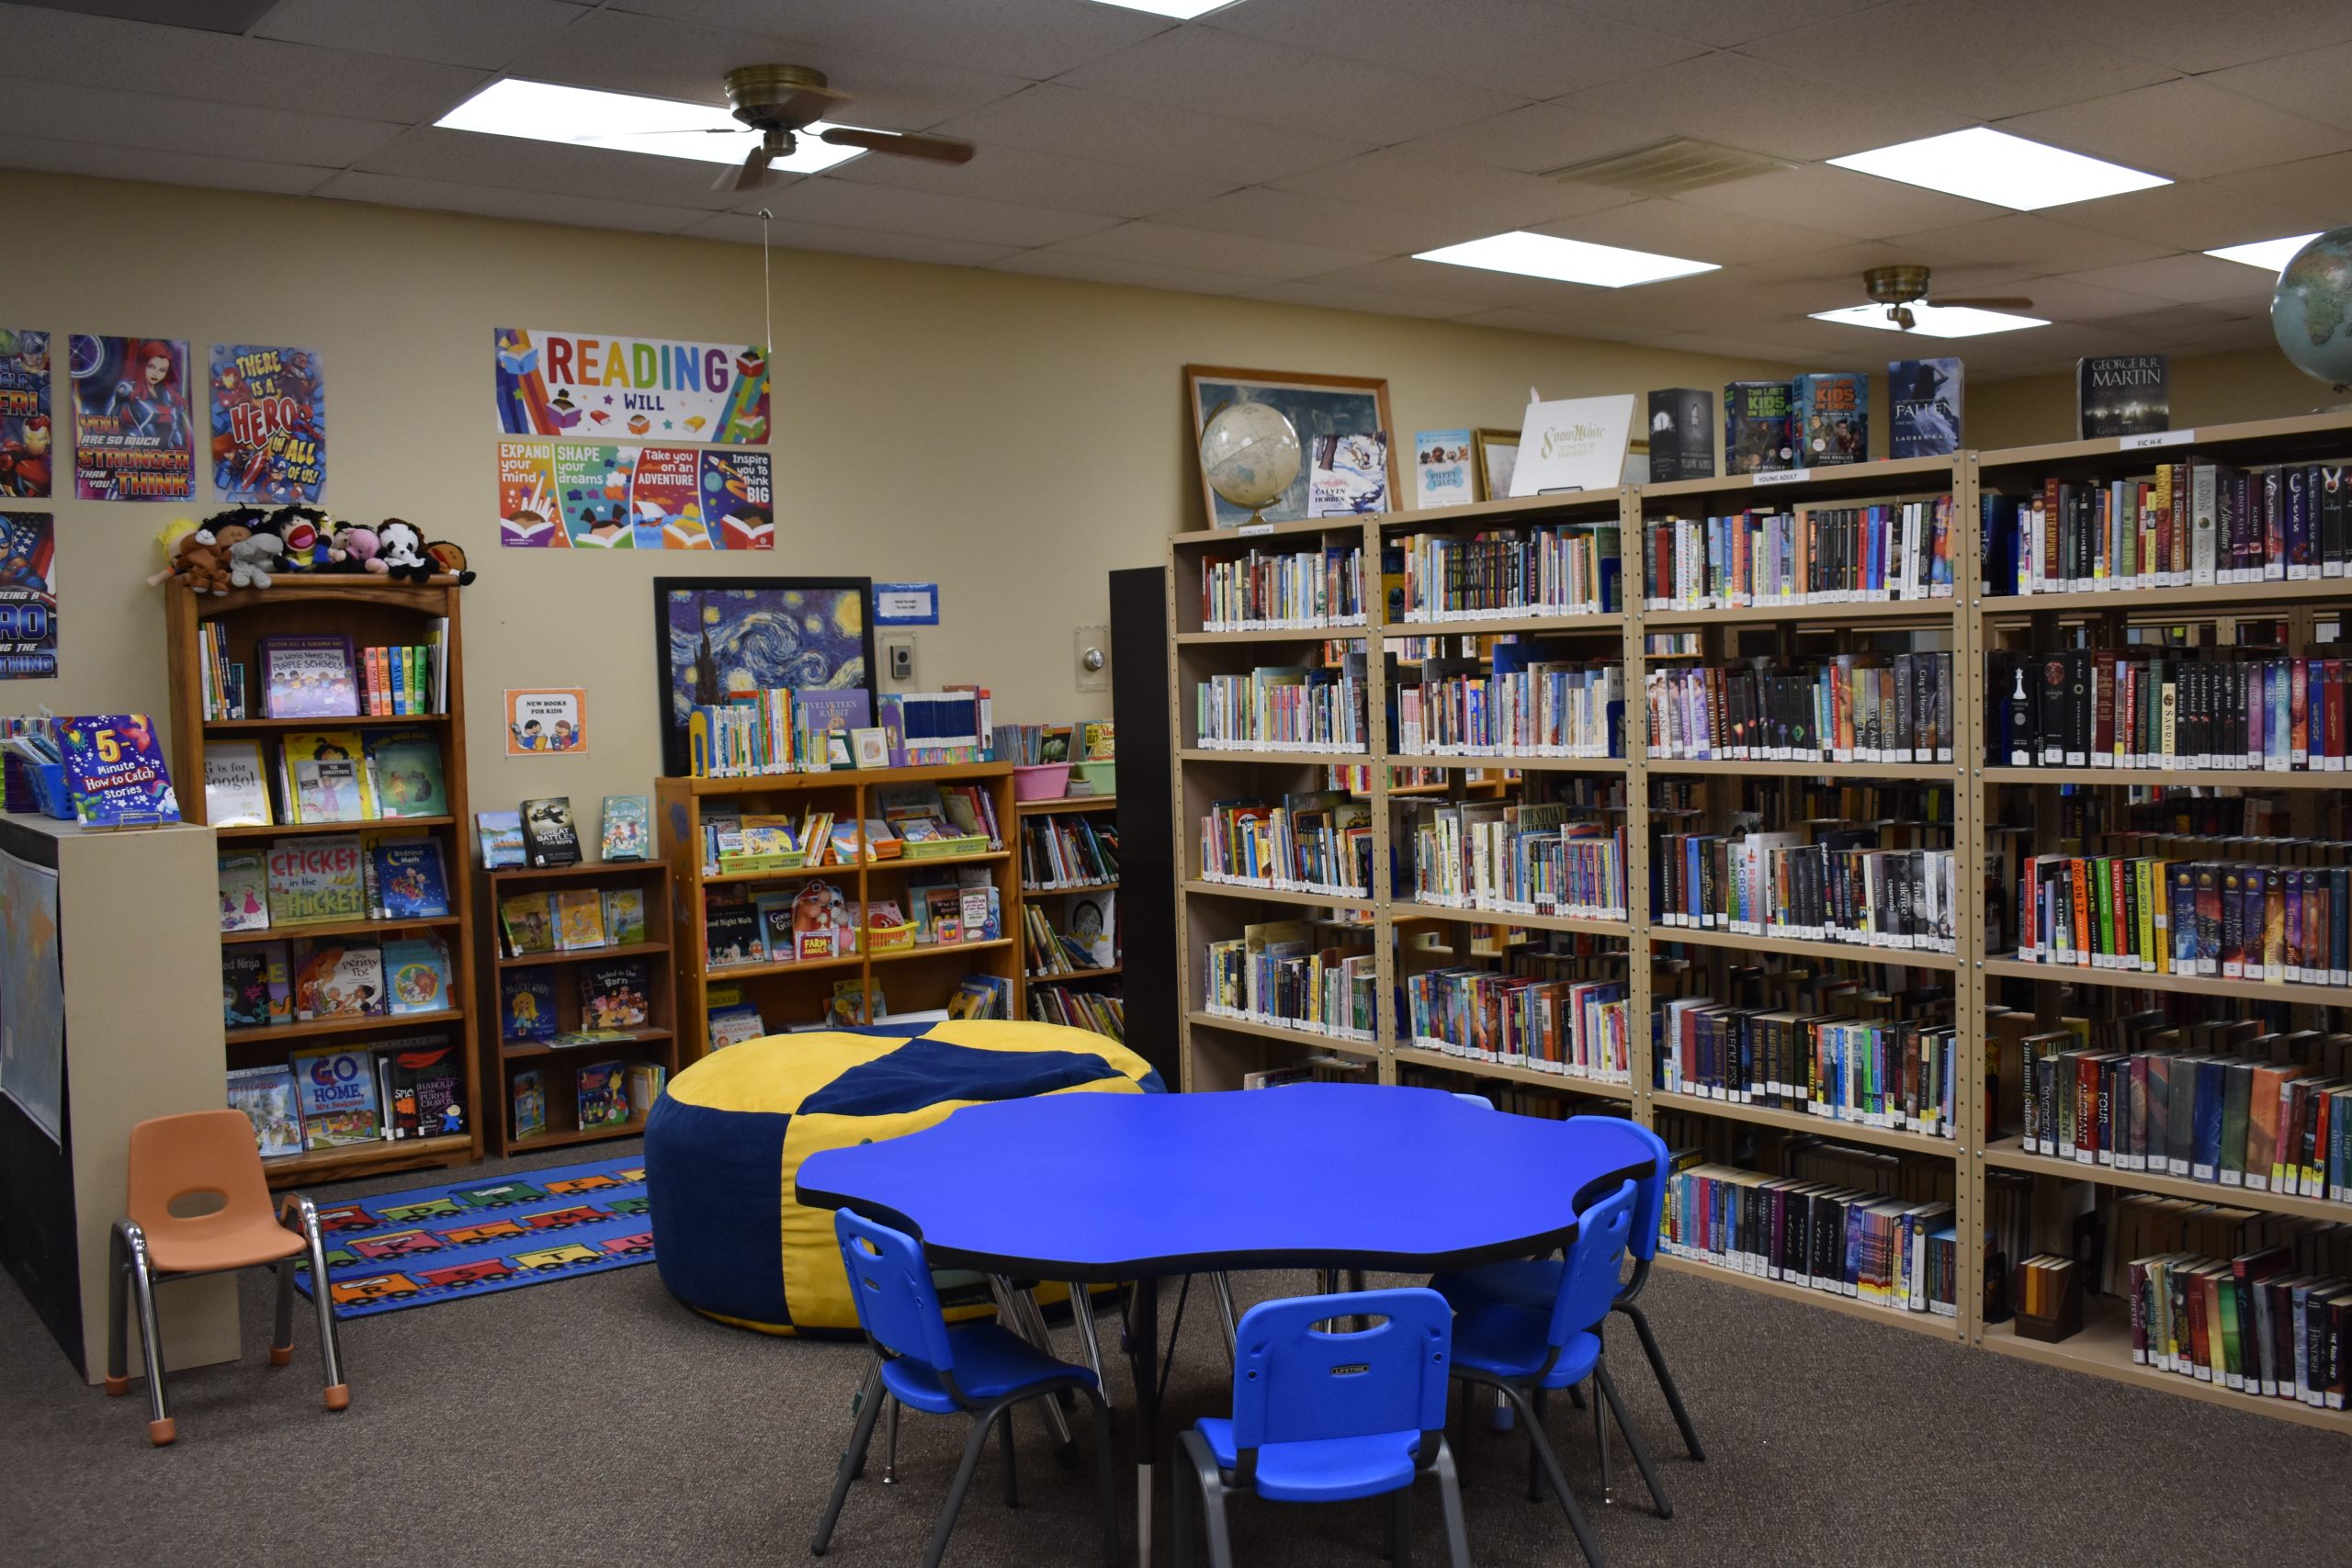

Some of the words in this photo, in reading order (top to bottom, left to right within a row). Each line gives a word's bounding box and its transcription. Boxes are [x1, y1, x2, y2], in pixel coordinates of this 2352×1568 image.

[236, 350, 281, 378] THERE
[548, 336, 729, 394] READING
[2092, 357, 2139, 370] GEORGE
[2092, 368, 2161, 387] MARTIN
[251, 383, 263, 396] IS
[266, 381, 275, 394] A
[1763, 386, 1785, 397] LAST
[1815, 388, 1855, 401] KIDS
[624, 394, 664, 412] WILL
[1748, 396, 1785, 410] KIDS
[1895, 402, 1953, 419] FALLEN
[79, 416, 119, 434] YOU
[230, 398, 296, 448] HERO
[81, 435, 106, 445] ARE
[107, 435, 123, 445] SO
[125, 436, 159, 446] MUCH
[2150, 438, 2163, 446] H-K
[272, 437, 283, 452] IN
[286, 439, 315, 464] ALL
[501, 445, 550, 459] EXPAND
[558, 447, 599, 462] SHAPE
[645, 450, 671, 461] Take
[673, 451, 693, 463] you
[78, 448, 189, 469] STRONGER
[502, 458, 530, 471] your
[732, 454, 768, 467] Inspire
[288, 467, 300, 479] OF
[301, 470, 318, 483] US!
[558, 462, 585, 474] your
[661, 463, 676, 472] on
[679, 463, 694, 472] an
[737, 465, 755, 477] you
[758, 464, 768, 475] to
[116, 472, 188, 495] THINK
[503, 470, 537, 483] mind
[558, 473, 603, 485] dreams
[638, 474, 694, 486] ADVENTURE
[747, 487, 770, 503] BIG
[2290, 474, 2301, 533] Cress
[2220, 507, 2233, 549] Bloodlines
[2046, 513, 2057, 559] STEAMPUNK!
[2123, 539, 2133, 565] RUIN
[31, 591, 40, 600] A
[17, 643, 38, 652] THE
[285, 652, 303, 661] World
[273, 661, 302, 671] PURPLE
[305, 660, 345, 671] SCHOOLS
[393, 665, 403, 691] MATH
[1897, 670, 1905, 686] City
[1918, 670, 1927, 686] City
[2126, 688, 2133, 696] by
[2251, 685, 2259, 706] fated
[2266, 684, 2275, 705] echo
[2276, 674, 2285, 705] mystic
[810, 701, 857, 710] VELVETEEN
[819, 709, 850, 717] RABBIT
[1884, 698, 1893, 719] City
[1920, 695, 1928, 730] Heavenly
[97, 761, 136, 775] Minute
[218, 763, 228, 773] is
[231, 762, 246, 773] for
[85, 777, 109, 791] How
[111, 773, 123, 785] to
[125, 767, 154, 783] Catch
[104, 785, 142, 799] Stories
[537, 833, 575, 842] BATTLES
[401, 856, 421, 864] Math
[2074, 862, 2082, 882] DOG
[289, 879, 299, 887] in
[301, 877, 316, 886] the
[1887, 879, 1896, 911] crescendo
[1900, 882, 1909, 915] silence
[1913, 880, 1924, 910] finale
[2075, 886, 2083, 898] ON
[2076, 902, 2084, 915] IT
[720, 918, 738, 927] Night
[739, 916, 752, 925] Walk
[2233, 919, 2242, 946] HOUSE
[804, 938, 826, 948] FARM
[236, 958, 260, 969] Ninja
[627, 969, 638, 977] the
[605, 977, 628, 987] Barn
[311, 1056, 357, 1088] GO
[314, 1085, 364, 1102] HOME,
[2078, 1080, 2087, 1146] ALLEGIANT
[2098, 1092, 2108, 1123] FOUR
[2344, 1134, 2352, 1160] linger
[2131, 1294, 2139, 1327] forever
